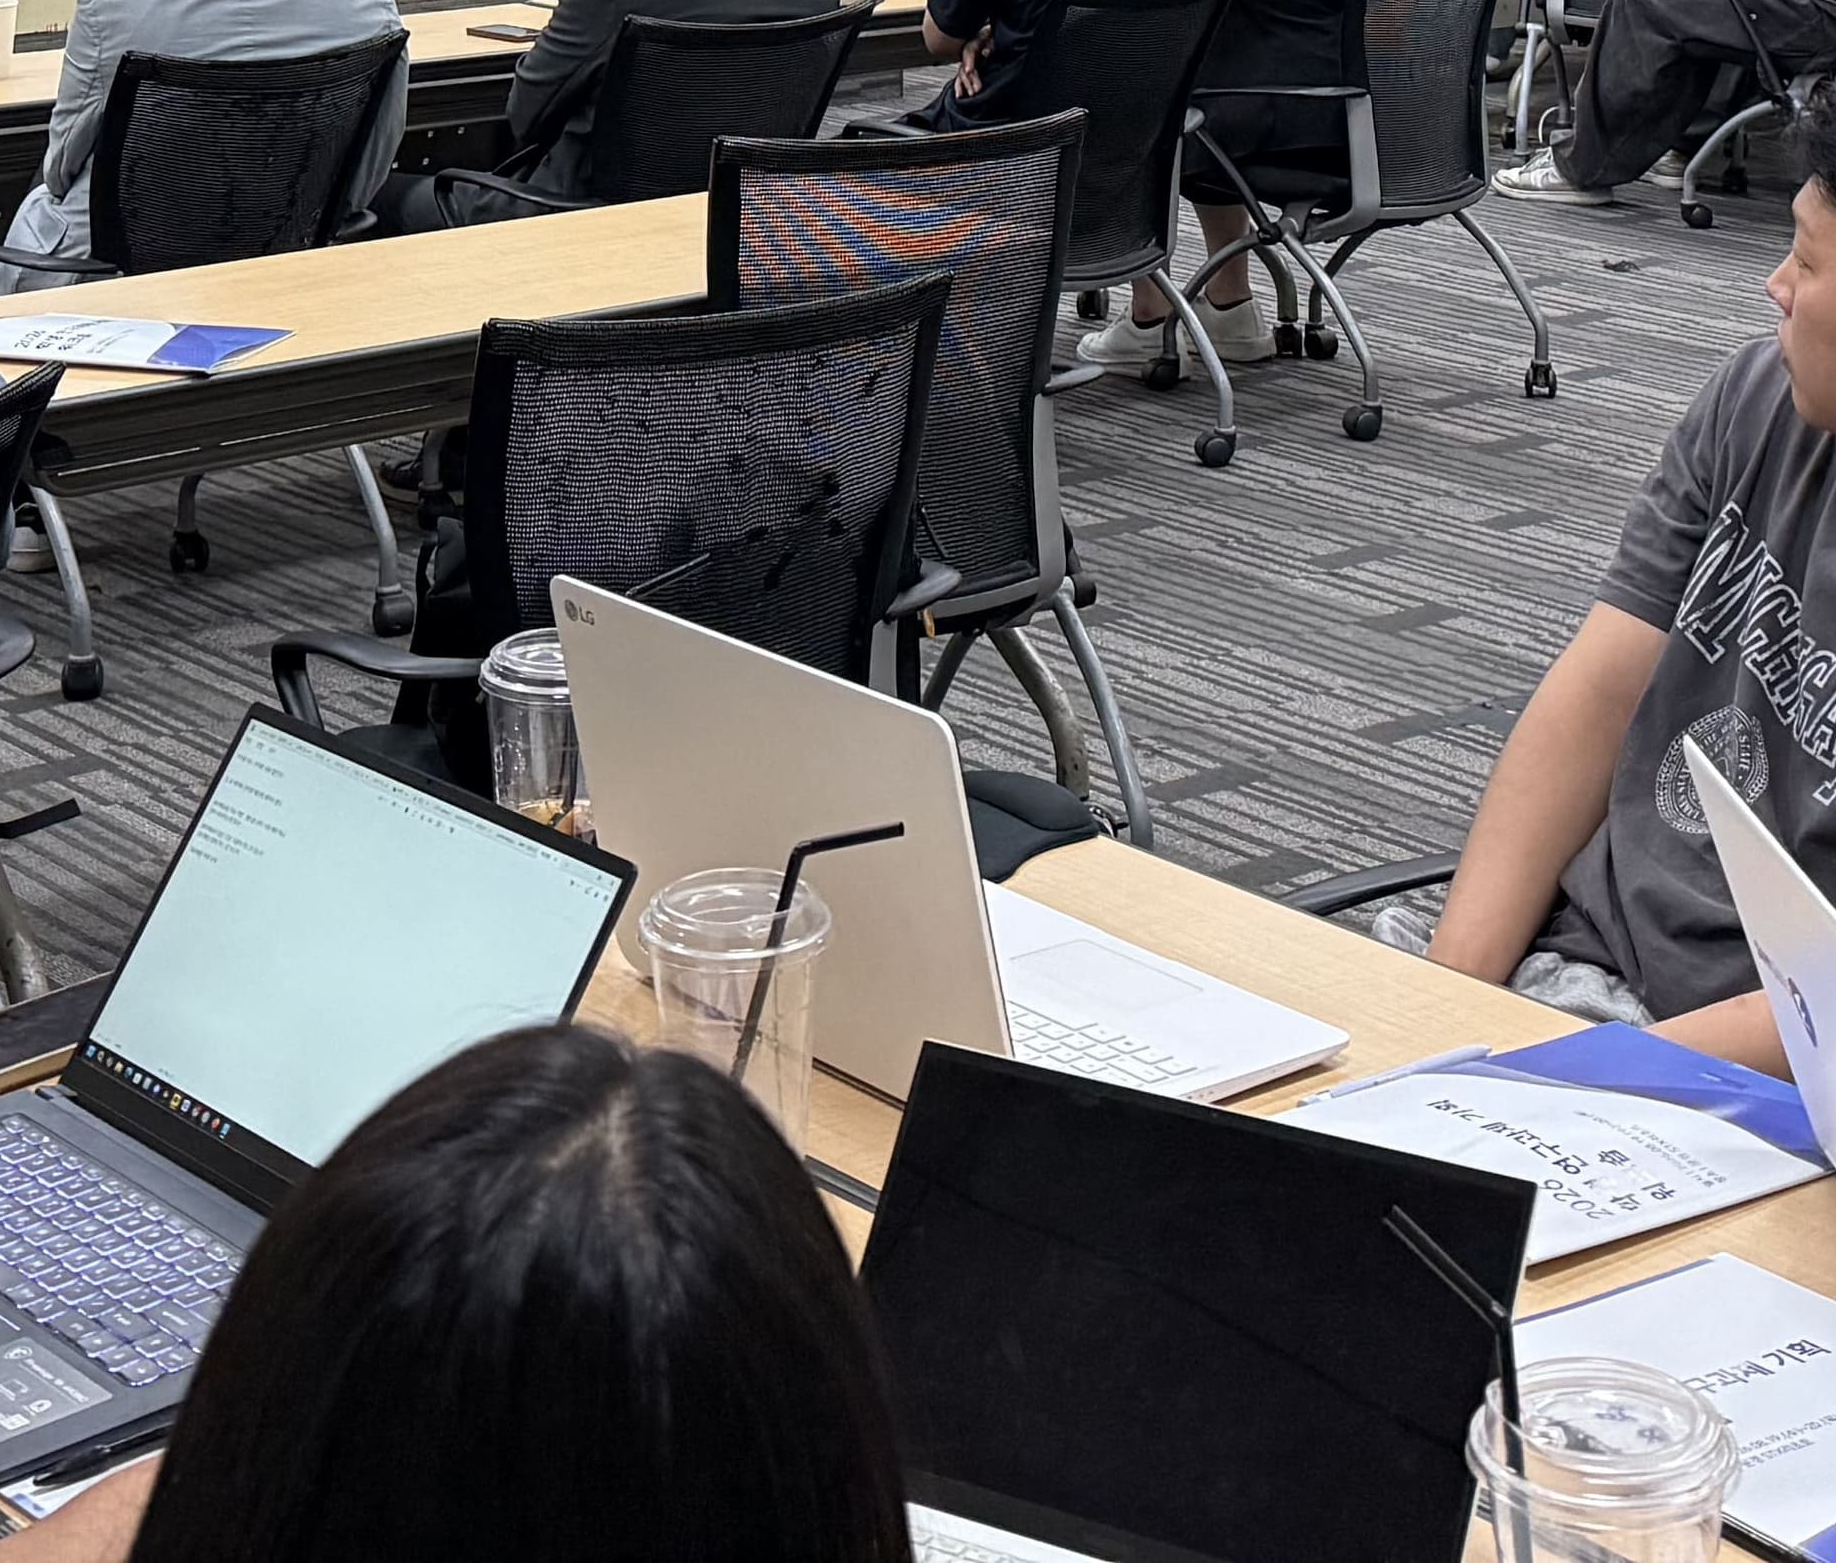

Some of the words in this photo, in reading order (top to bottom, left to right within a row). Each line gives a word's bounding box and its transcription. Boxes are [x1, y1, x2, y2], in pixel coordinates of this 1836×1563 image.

[1597, 1148, 1678, 1201] 워숍
[1541, 1178, 1616, 1221] 2026
[1761, 1339, 1832, 1368] 기획
